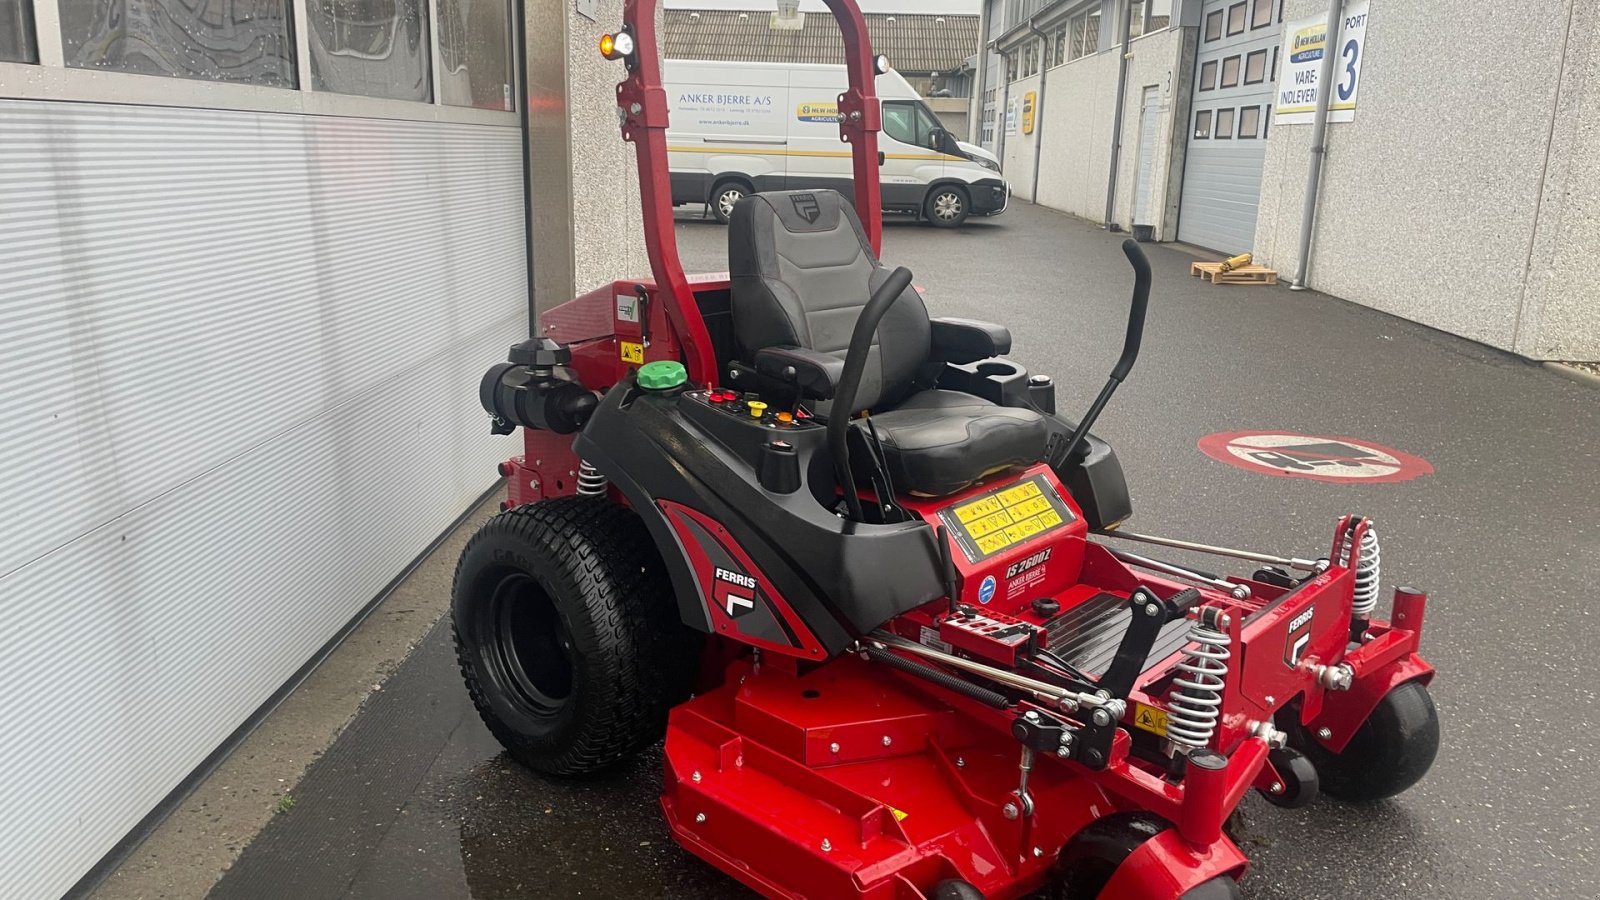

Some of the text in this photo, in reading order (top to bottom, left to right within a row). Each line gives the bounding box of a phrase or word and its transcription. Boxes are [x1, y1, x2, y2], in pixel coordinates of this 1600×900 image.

[1345, 14, 1367, 30] PORT
[1300, 33, 1326, 47] NEW HOLLAN
[1295, 69, 1318, 85] VARE-
[1338, 39, 1359, 101] 3
[1166, 71, 1172, 92] 3
[680, 93, 771, 106] ANKER BJERRE A/S
[1281, 88, 1317, 105] INDLEVERI
[699, 119, 750, 127] www.ankerbjerre.dk
[1018, 548, 1052, 573] 2600Z
[715, 567, 756, 589] FERRIS
[1008, 574, 1025, 590] ANKER
[1288, 606, 1314, 634] FERRIS
